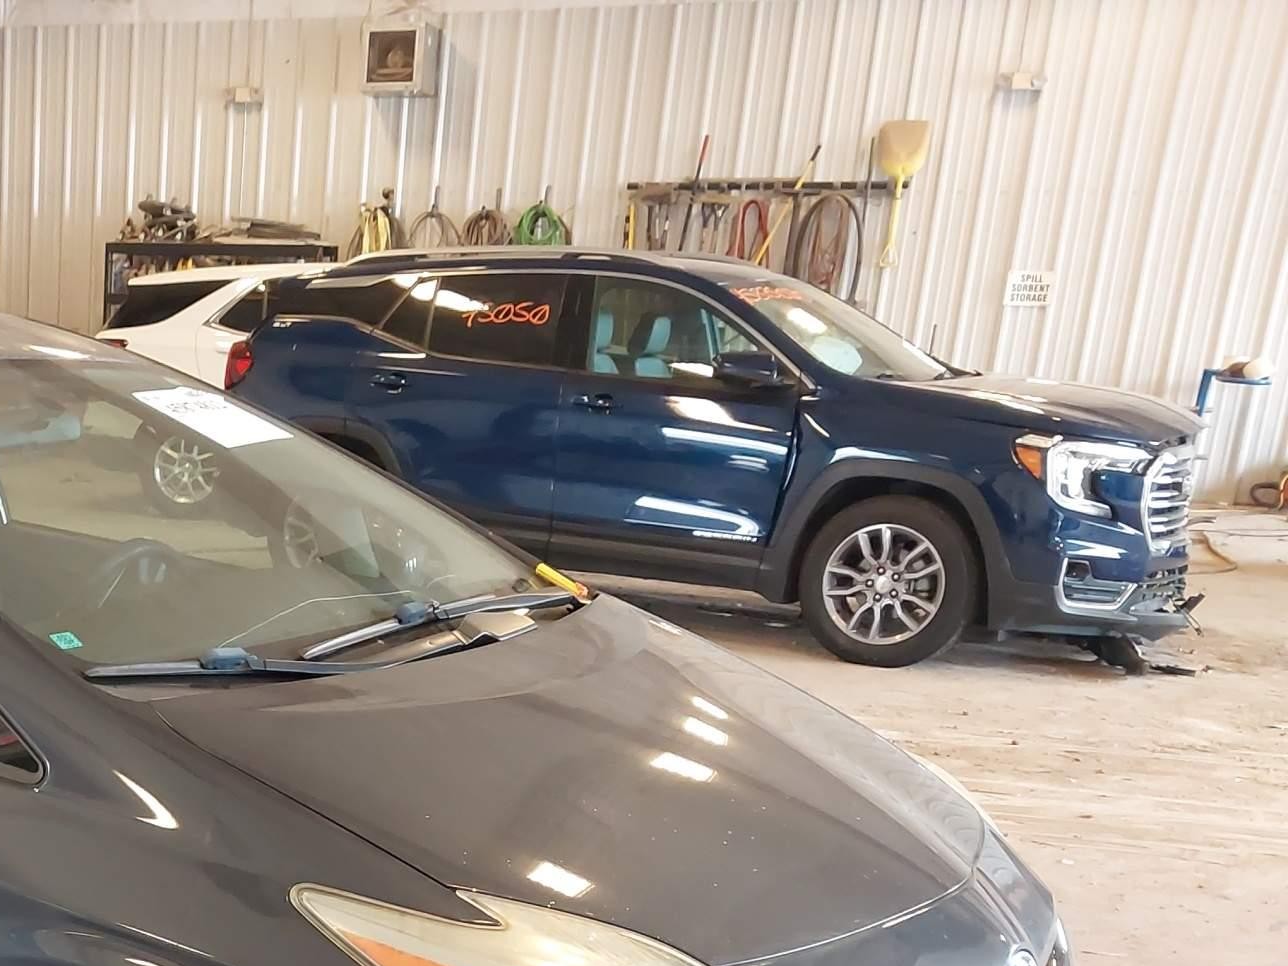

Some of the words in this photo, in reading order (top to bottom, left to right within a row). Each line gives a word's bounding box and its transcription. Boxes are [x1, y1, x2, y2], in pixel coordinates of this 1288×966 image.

[1020, 273, 1042, 283] SPILL
[1011, 283, 1050, 292] SORBENT
[1010, 293, 1048, 302] STORAGE
